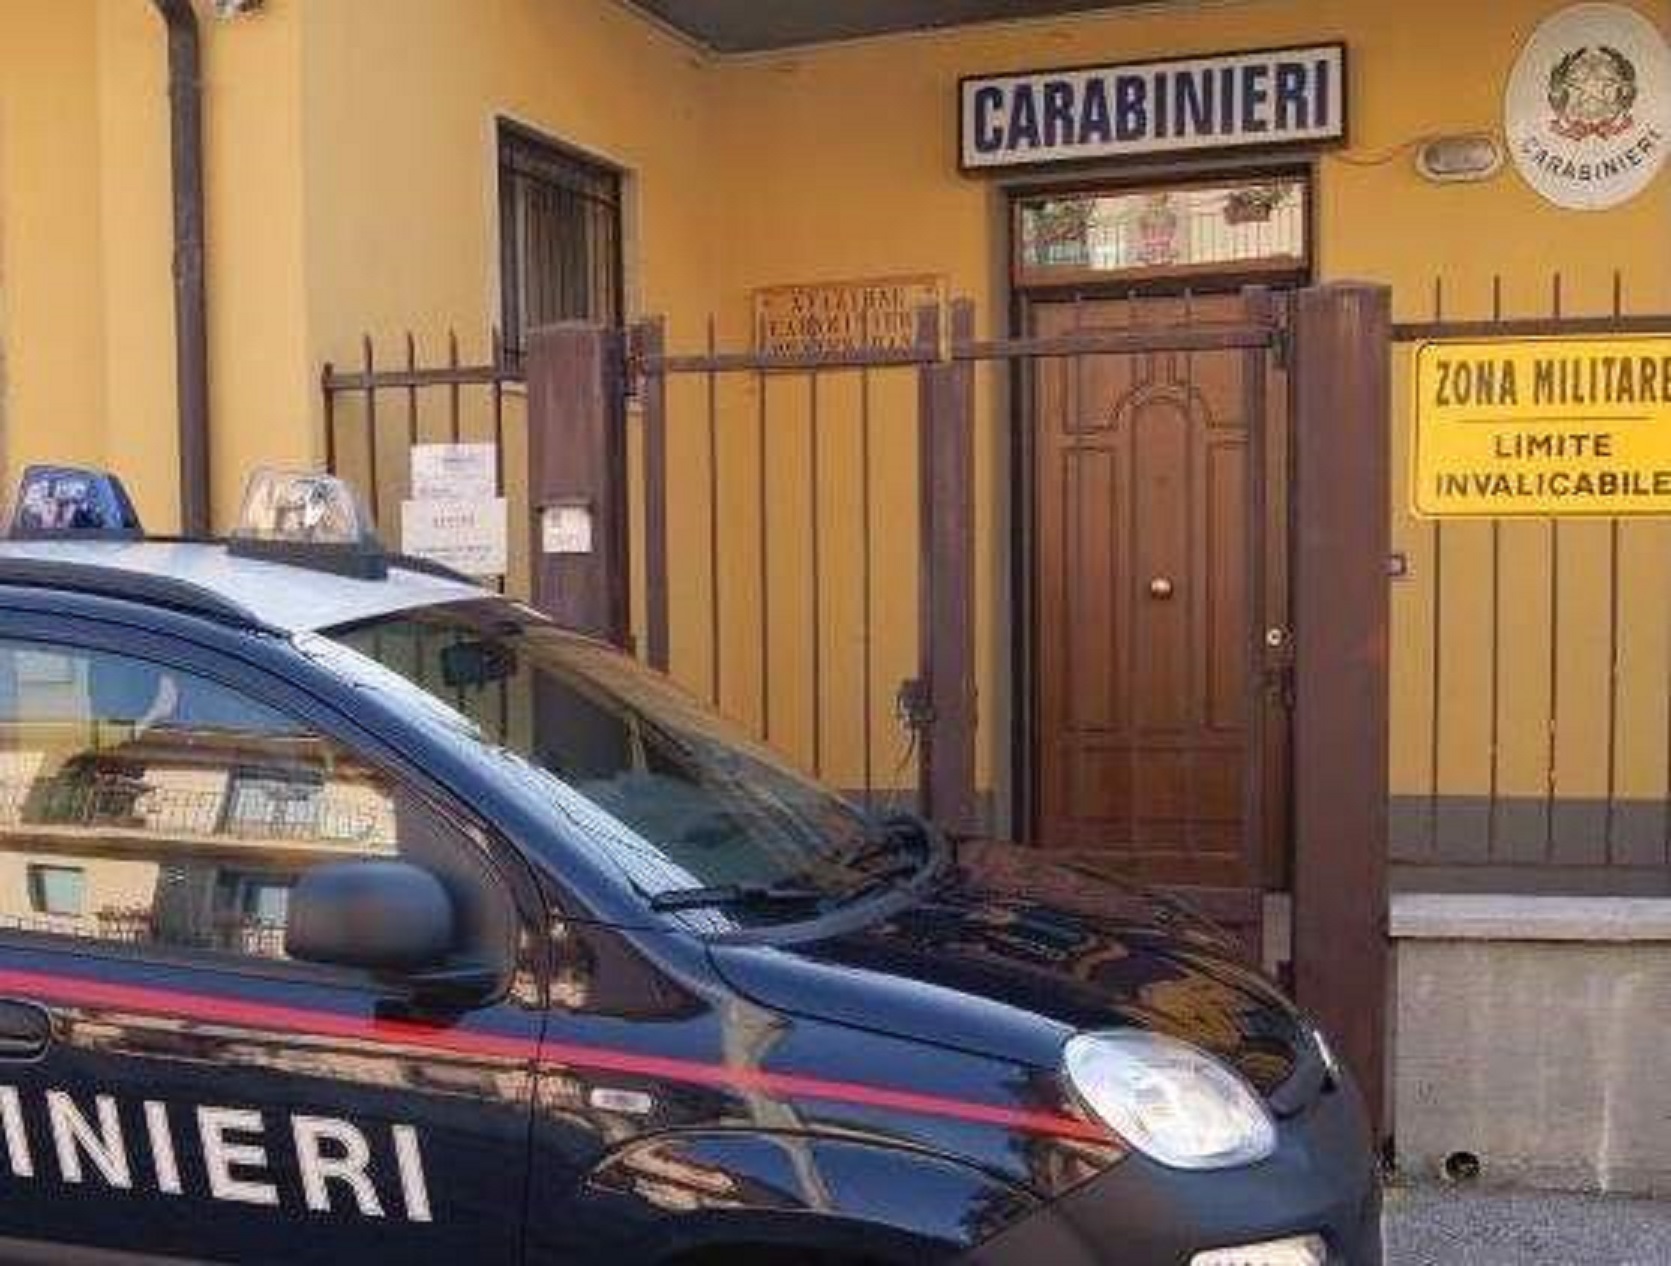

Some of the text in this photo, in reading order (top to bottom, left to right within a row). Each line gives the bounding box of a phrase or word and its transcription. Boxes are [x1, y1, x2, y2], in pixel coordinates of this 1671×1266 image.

[973, 60, 1330, 153] CARABINIERI
[1435, 356, 1671, 406] ZONA MILITARE
[1494, 434, 1612, 458] LIMITE
[1435, 470, 1671, 498] INVALICABILE
